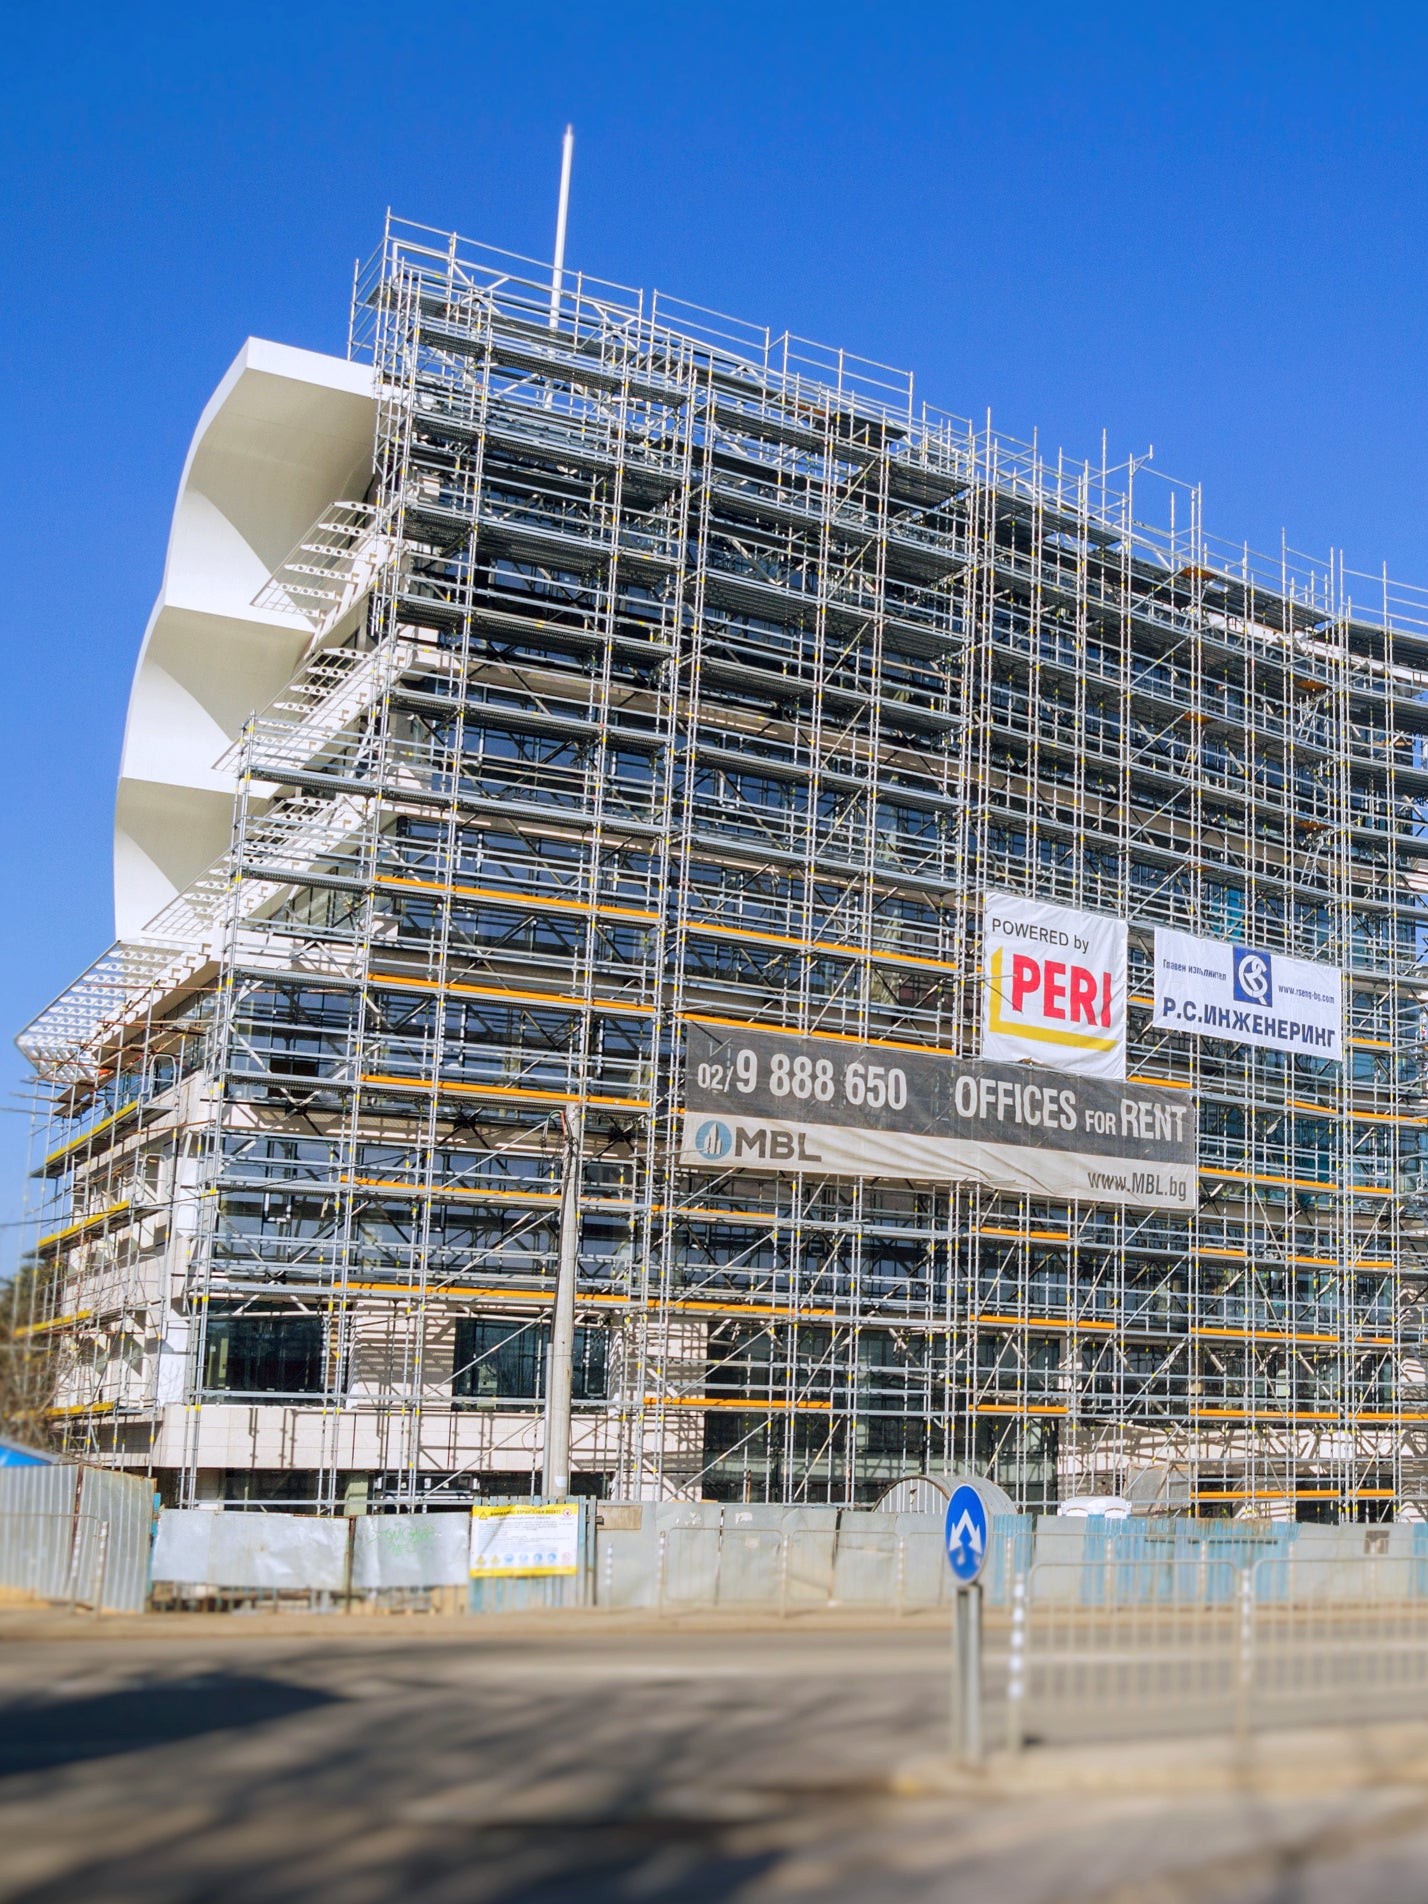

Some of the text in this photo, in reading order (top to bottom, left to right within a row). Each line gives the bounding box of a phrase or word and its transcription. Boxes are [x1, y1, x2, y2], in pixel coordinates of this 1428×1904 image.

[992, 918, 1089, 954] POWERED by
[1163, 959, 1186, 972] Главен
[1012, 953, 1112, 1028] PERI
[1162, 997, 1335, 1048] Р.С.ИНЖЕНЕРИНГ
[769, 1053, 835, 1101] 888
[845, 1063, 907, 1110] 650
[954, 1075, 1187, 1142] OFFICES FOR RENT
[734, 1126, 822, 1162] MBL
[1087, 1172, 1187, 1200] www.MBL.bg
